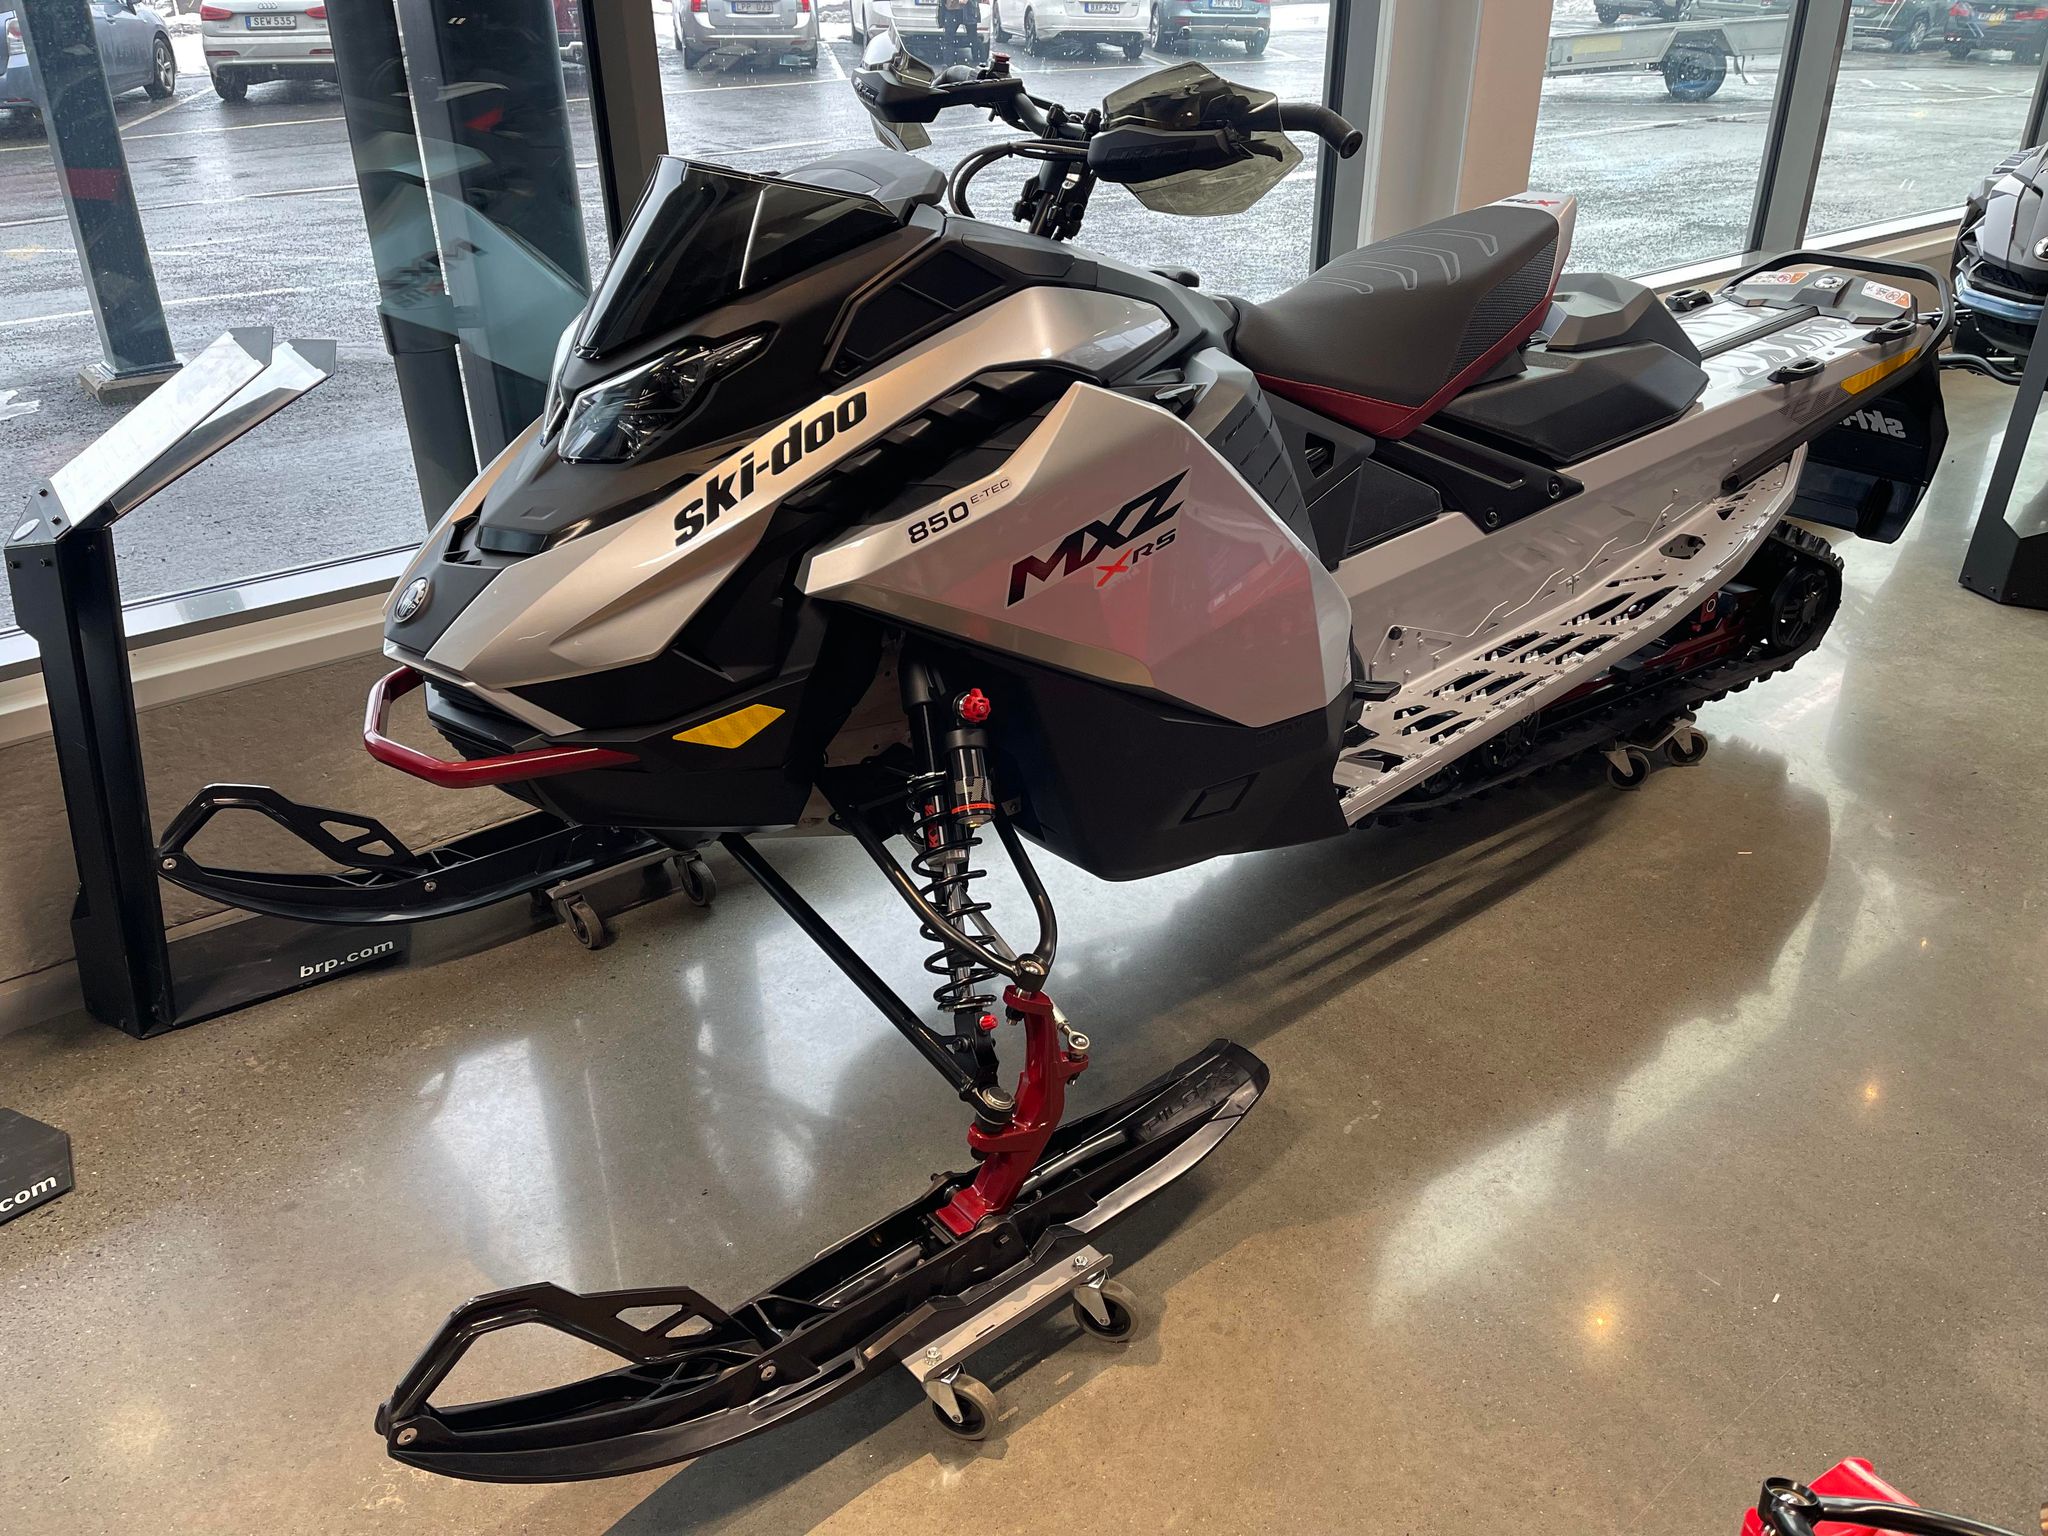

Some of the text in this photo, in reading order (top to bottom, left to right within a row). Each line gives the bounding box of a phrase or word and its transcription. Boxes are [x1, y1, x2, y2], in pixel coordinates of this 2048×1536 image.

[253, 16, 292, 26] SEW 535
[674, 391, 867, 547] ski-doo
[907, 479, 1011, 544] 850 E-TEC
[1006, 467, 1191, 608] MXZ
[300, 940, 394, 978] brp.com
